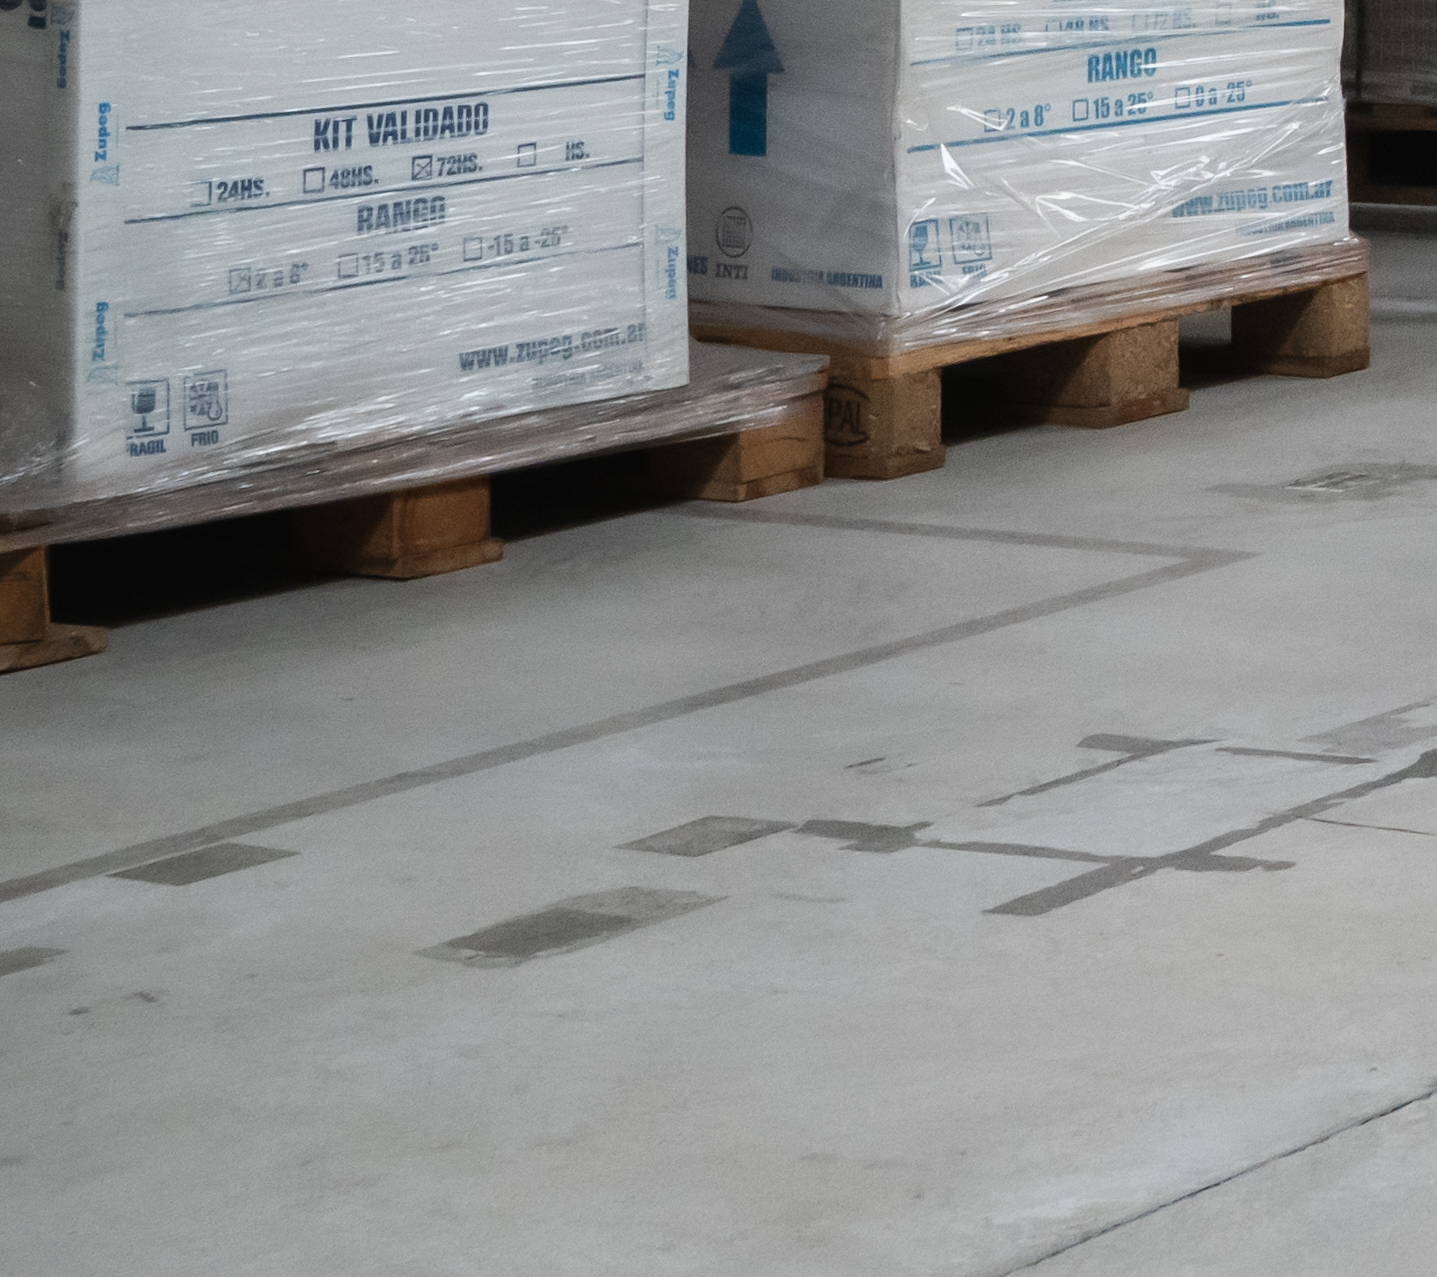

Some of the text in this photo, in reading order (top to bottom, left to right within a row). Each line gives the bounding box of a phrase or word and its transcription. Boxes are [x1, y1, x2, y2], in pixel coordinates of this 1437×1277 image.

[1087, 47, 1158, 83] RANGO
[664, 69, 680, 121] Zupeg
[1093, 90, 1155, 119] 15 a 25°
[1208, 87, 1218, 106] a
[94, 102, 111, 163] Zupeg
[313, 101, 490, 153] KIT VALIDADO
[1006, 102, 1052, 130] 2 a 8°
[216, 141, 591, 202] 24HS. 48HS. 72HS. HS.
[356, 195, 447, 235] RANGO
[519, 235, 530, 251] a
[715, 262, 748, 280] INTI
[827, 269, 884, 289] ARGENTINA
[92, 302, 109, 361] Zupeg
[458, 321, 647, 372] www.zupeg.com.ar
[191, 430, 219, 447] FRIO
